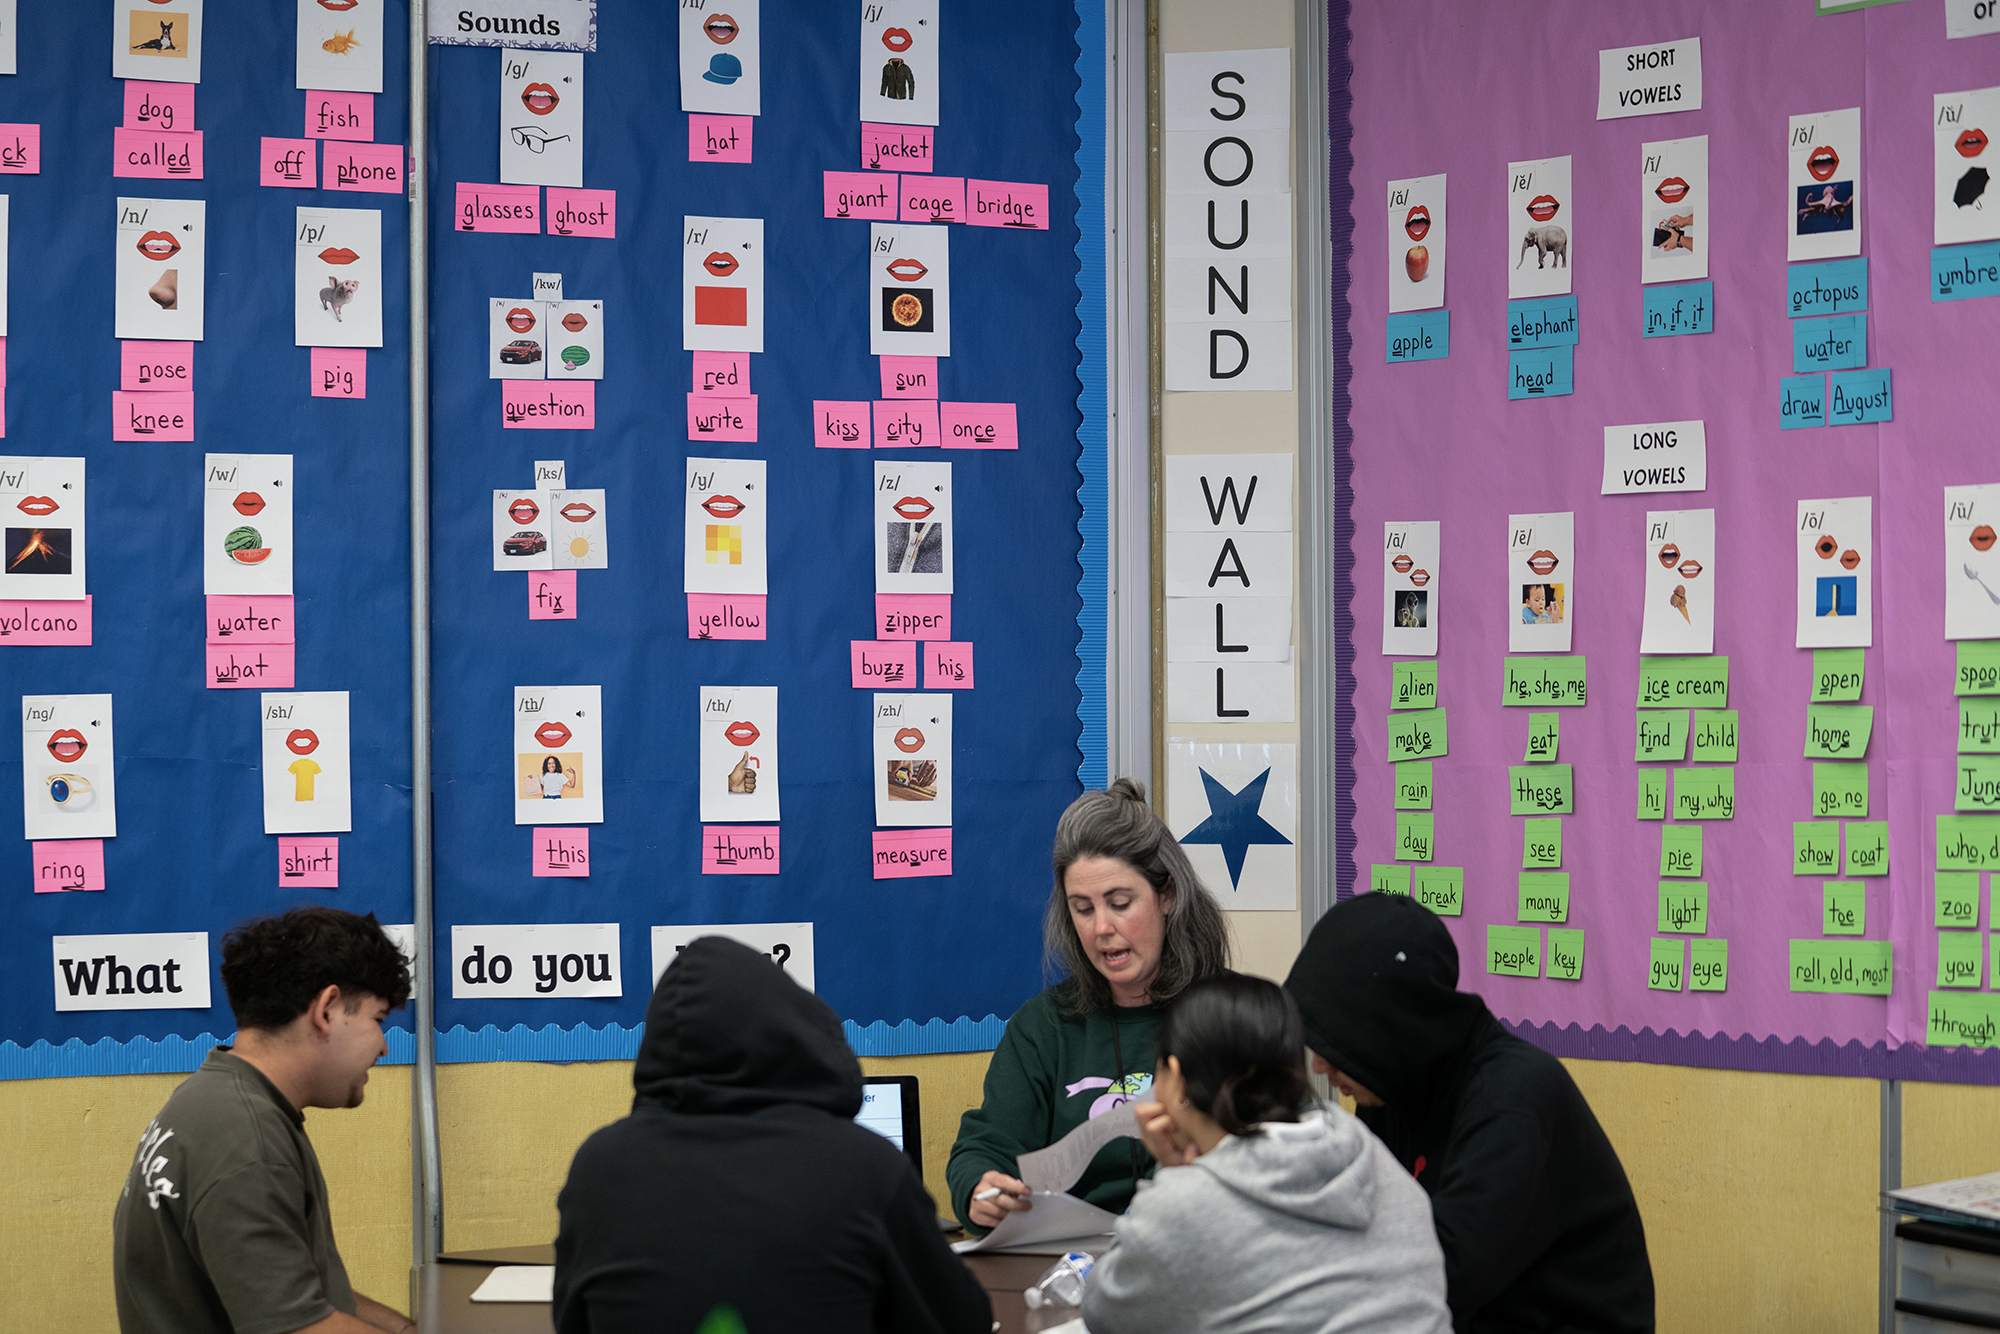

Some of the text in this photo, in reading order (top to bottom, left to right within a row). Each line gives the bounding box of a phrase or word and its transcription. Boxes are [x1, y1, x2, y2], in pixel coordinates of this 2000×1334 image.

[864, 5, 883, 23] /j/
[1974, 0, 1997, 20] or
[458, 10, 560, 36] Sounds
[505, 60, 529, 79] /g/
[1627, 49, 1675, 72] SHORT
[1619, 84, 1681, 107] VOWELS
[139, 94, 173, 128] dog
[317, 102, 359, 127] fish
[706, 126, 739, 151] hat
[1792, 125, 1814, 146] /ŏ/
[128, 142, 190, 167] called
[870, 135, 929, 164] jacket
[274, 151, 305, 174] off
[338, 157, 396, 186] phone
[462, 194, 534, 225] glasses
[838, 184, 888, 212] giant
[909, 197, 953, 218] cage
[977, 191, 1035, 225] bridge
[120, 207, 148, 226] /n/
[556, 200, 609, 231] ghost
[1204, 71, 1253, 379] SOUND
[299, 224, 325, 243] /p/
[687, 228, 708, 245] /r/
[874, 236, 894, 253] /s/
[534, 278, 561, 290] /kw/
[1939, 257, 2000, 287] umbre
[1793, 277, 1859, 310] octopus
[1693, 298, 1704, 323] it
[1511, 308, 1575, 341] elephant
[1392, 327, 1433, 358] apple
[1805, 330, 1852, 358] water
[140, 363, 187, 379] nose
[324, 366, 353, 394] pig
[704, 363, 738, 386] red
[897, 372, 926, 387] sun
[1516, 362, 1553, 388] head
[506, 393, 585, 421] question
[1782, 390, 1820, 415] draw
[1833, 380, 1888, 420] August
[131, 403, 184, 429] knee
[695, 406, 744, 429] write
[826, 412, 860, 437] kiss
[887, 413, 922, 445] city
[953, 422, 995, 437] once
[1634, 431, 1677, 450] LONG
[0, 471, 24, 488] /v/
[209, 467, 236, 482] /w/
[537, 467, 563, 481] /ks/
[691, 472, 714, 489] /y/
[879, 475, 900, 491] /z/
[1624, 467, 1685, 486] VOWELS
[1801, 511, 1824, 530] /ō/
[1387, 532, 1406, 548] /ā/
[1513, 529, 1531, 546] /ē/
[536, 583, 562, 608] fix
[1200, 475, 1257, 717] WALL
[0, 607, 78, 632] volcano
[218, 606, 281, 631] water
[699, 605, 760, 637] yellow
[885, 611, 943, 633] zipper
[216, 653, 268, 678] what
[862, 652, 904, 676] buzz
[938, 654, 964, 677] his
[1400, 672, 1434, 698] alien
[1646, 677, 1724, 696] ice cream
[1821, 672, 1859, 697] open
[1961, 667, 2000, 689] spoo
[26, 707, 54, 722] /ng/
[266, 705, 293, 720] /sh/
[519, 697, 544, 713] /th/
[706, 699, 731, 713] /th/
[877, 704, 901, 718] /zh/
[1396, 723, 1431, 748] make
[1531, 724, 1557, 749] eat
[1640, 722, 1669, 746] find
[1697, 722, 1734, 748] child
[1812, 717, 1850, 743] home
[1402, 782, 1427, 798] rain
[1517, 778, 1562, 802] these
[1646, 784, 1659, 806] hi
[1845, 791, 1862, 804] no
[545, 840, 586, 866] this
[714, 835, 774, 862] thumb
[1404, 827, 1427, 858] day
[1531, 843, 1555, 858] see
[1800, 840, 1833, 863] show
[1852, 837, 1884, 863] coat
[285, 847, 332, 872] shirt
[876, 846, 947, 865] measure
[1668, 846, 1693, 870] pie
[42, 862, 85, 887] ring
[1422, 881, 1456, 904] break
[1526, 896, 1562, 918] many
[1667, 898, 1700, 929] light
[1829, 898, 1854, 923] toe
[1942, 901, 1971, 916] zoo
[1494, 940, 1534, 971] people
[1555, 943, 1575, 977] key
[59, 955, 182, 996] What
[462, 946, 612, 993] do you
[1652, 962, 1679, 987] guy
[1693, 961, 1722, 984] eye
[1862, 959, 1888, 982] most
[1945, 960, 1974, 983] you
[1931, 1008, 1995, 1045] through
